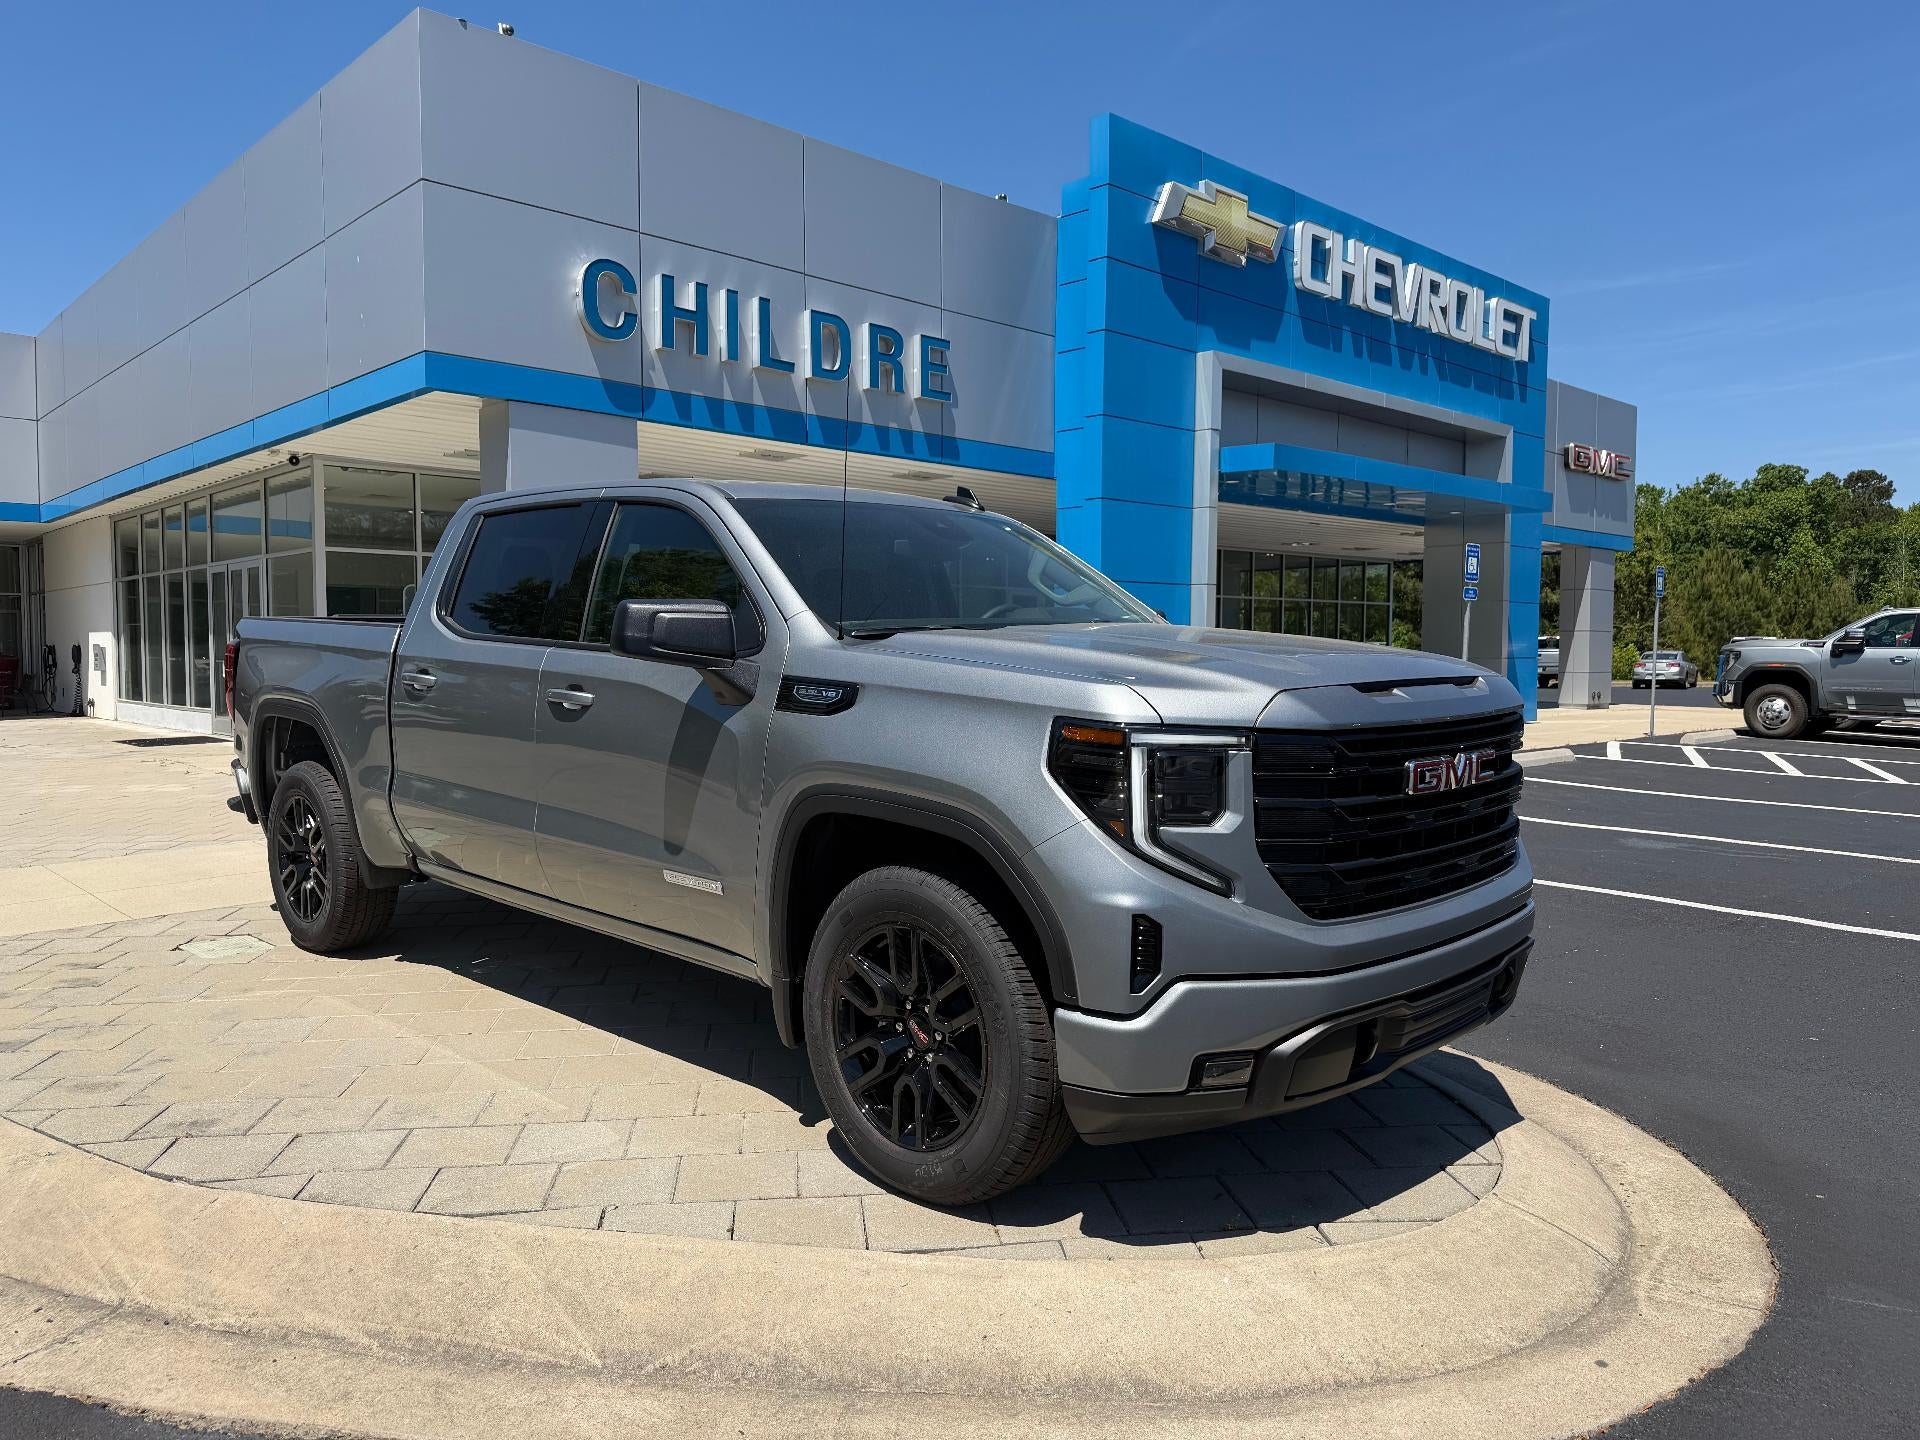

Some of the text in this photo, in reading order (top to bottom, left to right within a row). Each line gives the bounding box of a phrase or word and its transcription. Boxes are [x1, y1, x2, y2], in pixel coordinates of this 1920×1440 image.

[577, 258, 952, 402] CHILDRE
[1294, 220, 1537, 363] CHEVROLET
[1567, 442, 1632, 479] GMC
[1405, 750, 1496, 795] GMC
